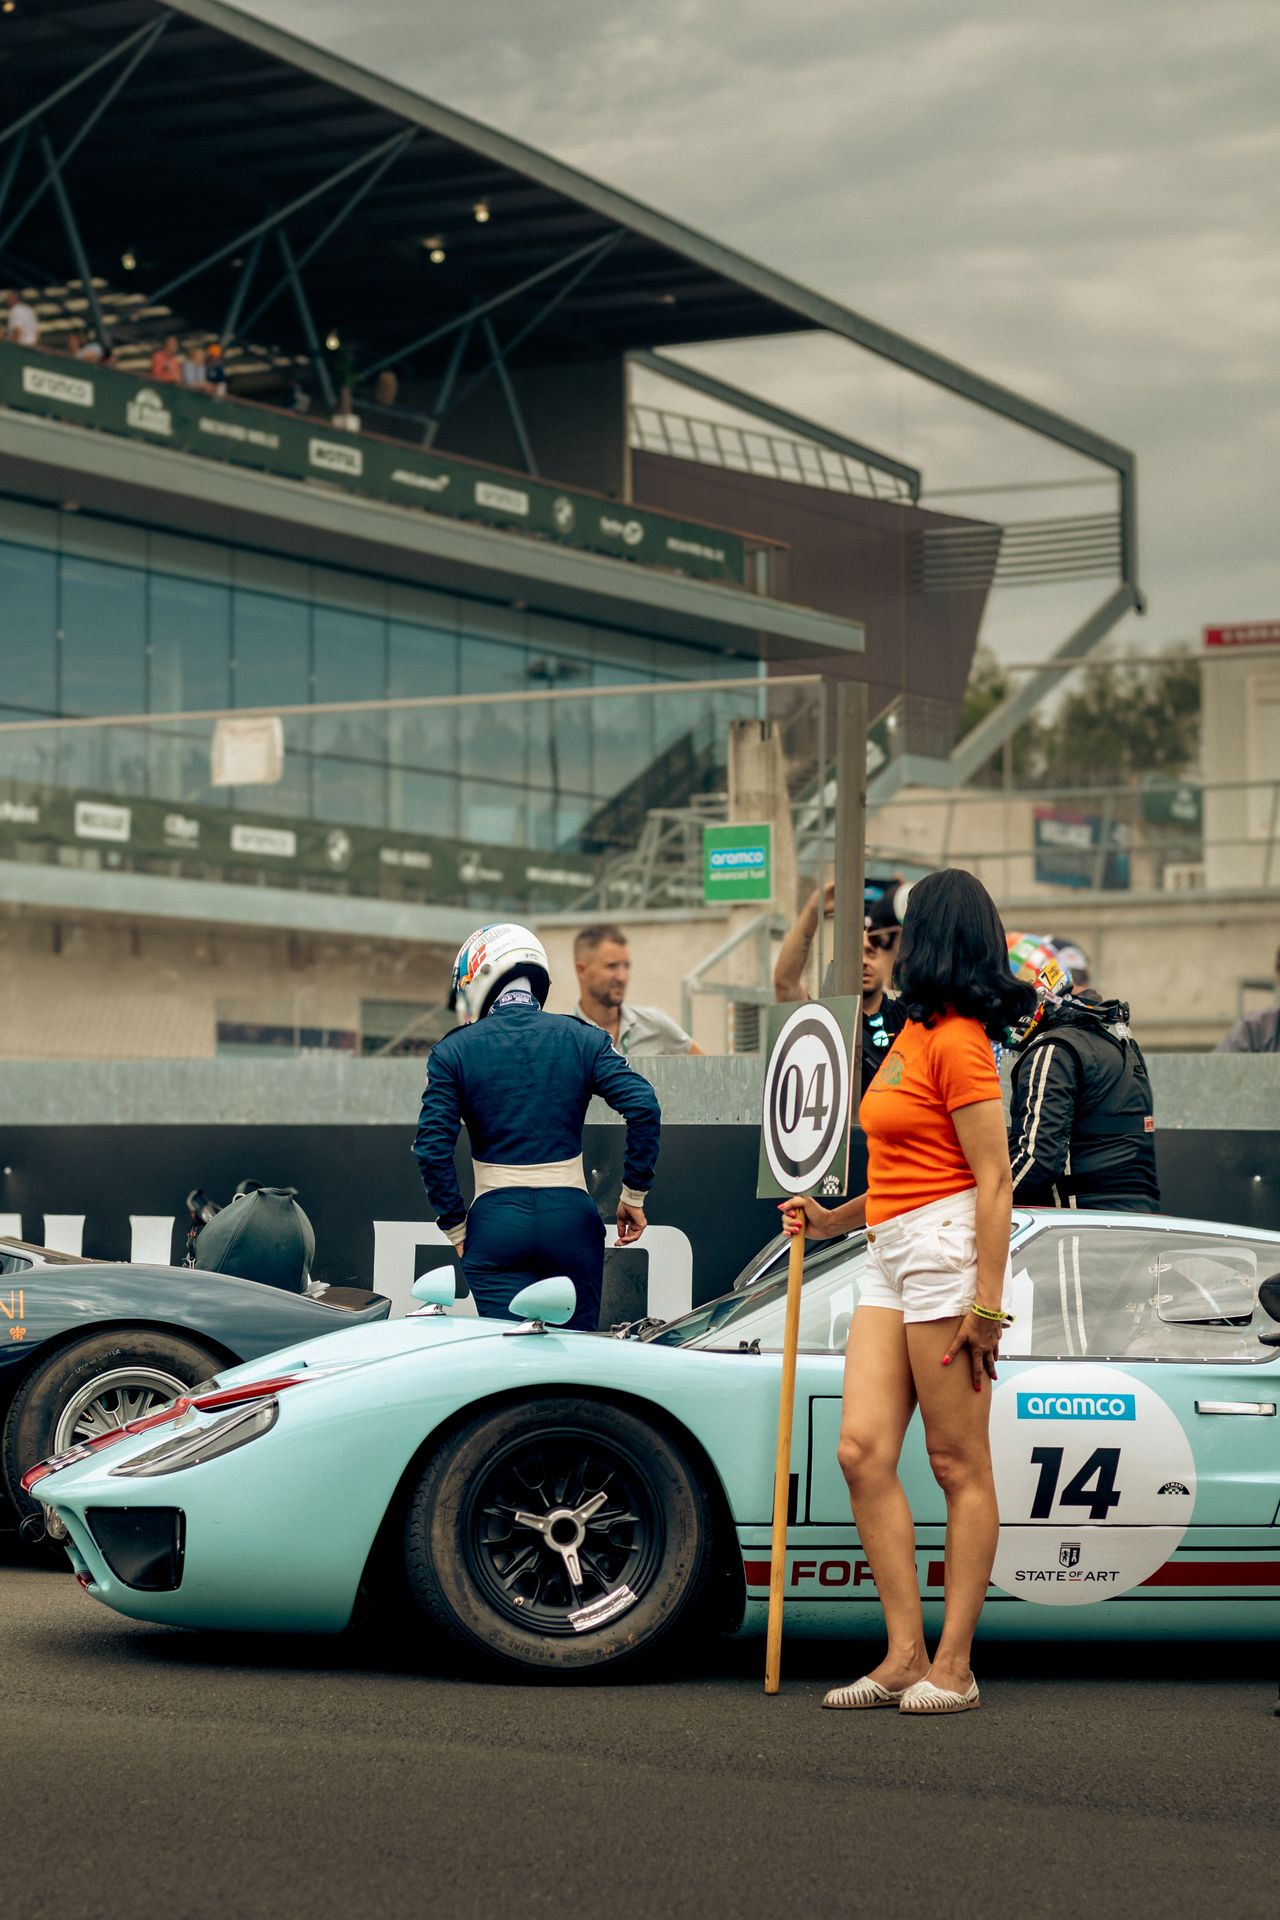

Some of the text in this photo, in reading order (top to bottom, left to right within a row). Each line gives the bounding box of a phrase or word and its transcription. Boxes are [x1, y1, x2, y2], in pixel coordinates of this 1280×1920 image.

[711, 852, 763, 865] aramco
[780, 1063, 829, 1133] 04
[1027, 1397, 1126, 1416] aramco
[1030, 1447, 1121, 1519] 14
[791, 1561, 917, 1586] FOR
[1015, 1571, 1067, 1581] STATE
[1084, 1571, 1120, 1581] ART
